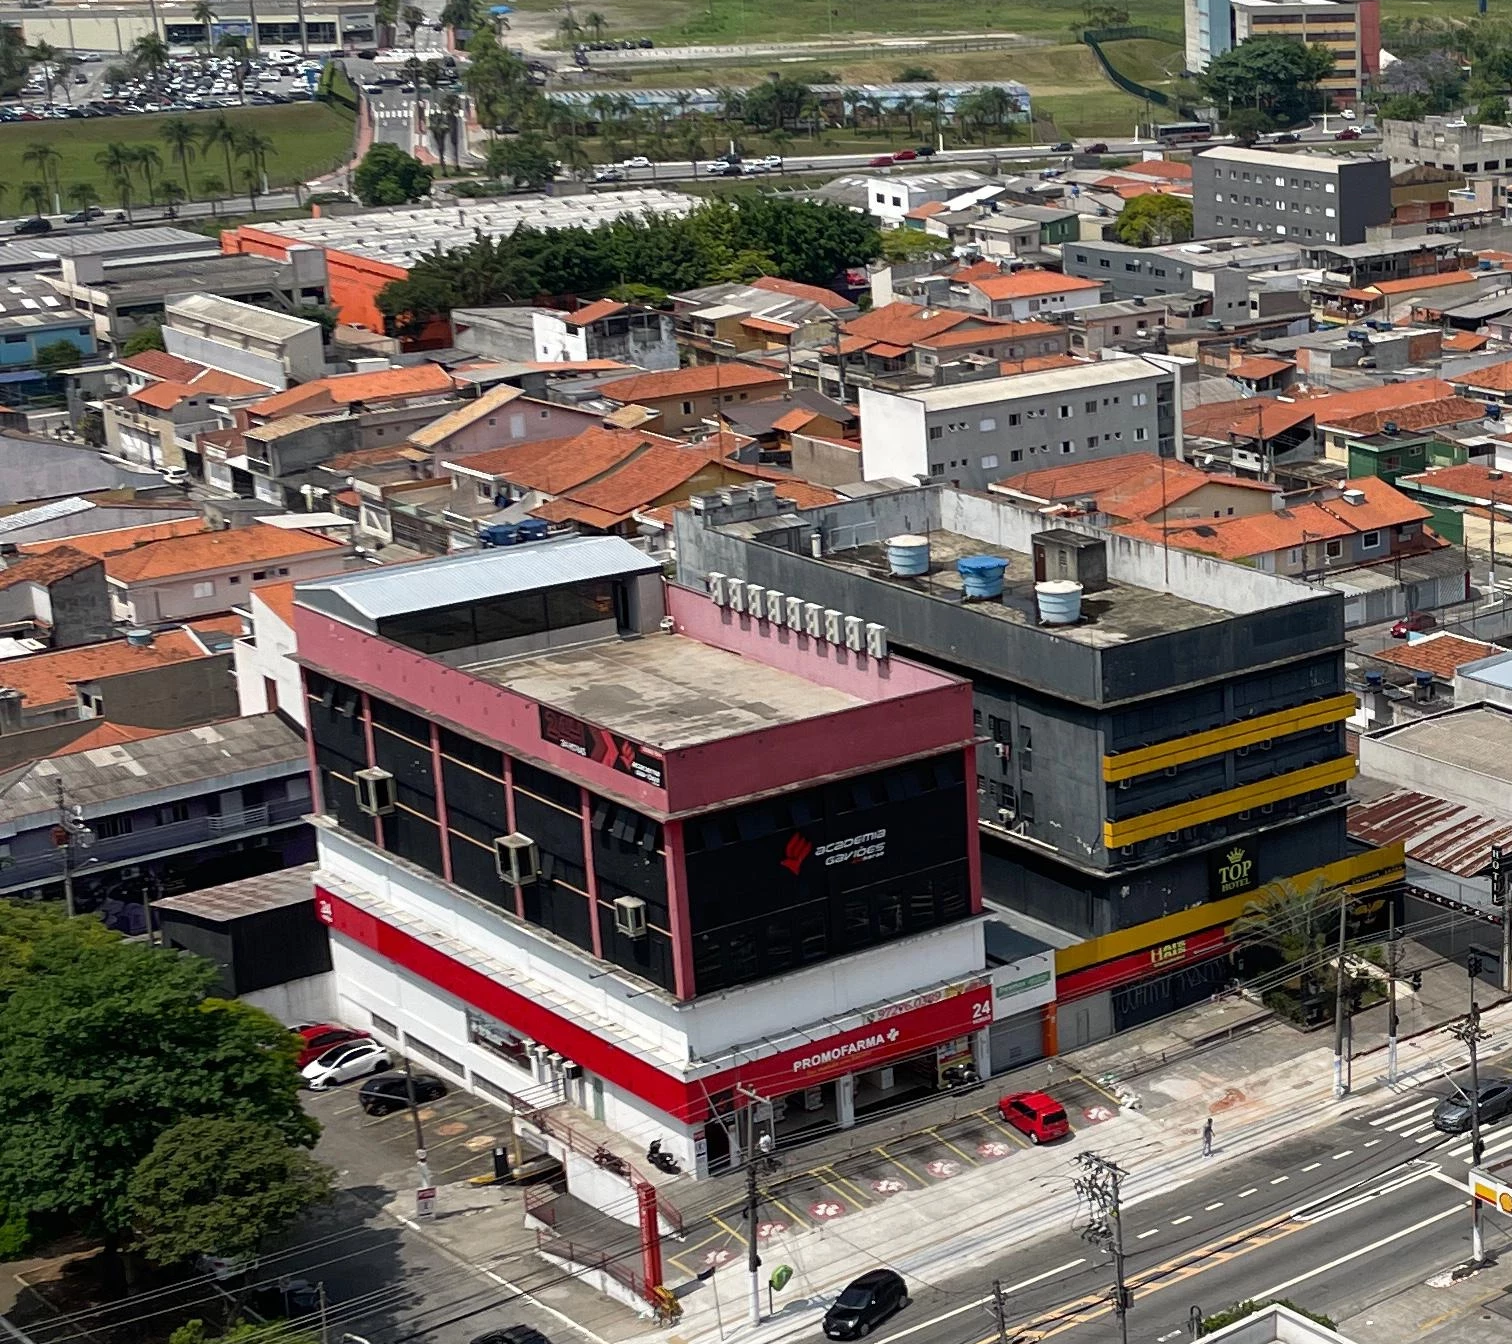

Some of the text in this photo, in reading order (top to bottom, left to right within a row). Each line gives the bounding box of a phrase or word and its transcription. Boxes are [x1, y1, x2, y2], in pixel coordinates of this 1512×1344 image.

[1218, 859, 1253, 884] TOP
[1221, 877, 1251, 893] HOTEL
[972, 1000, 991, 1019] 24
[792, 1033, 886, 1073] PROMOFARMA
